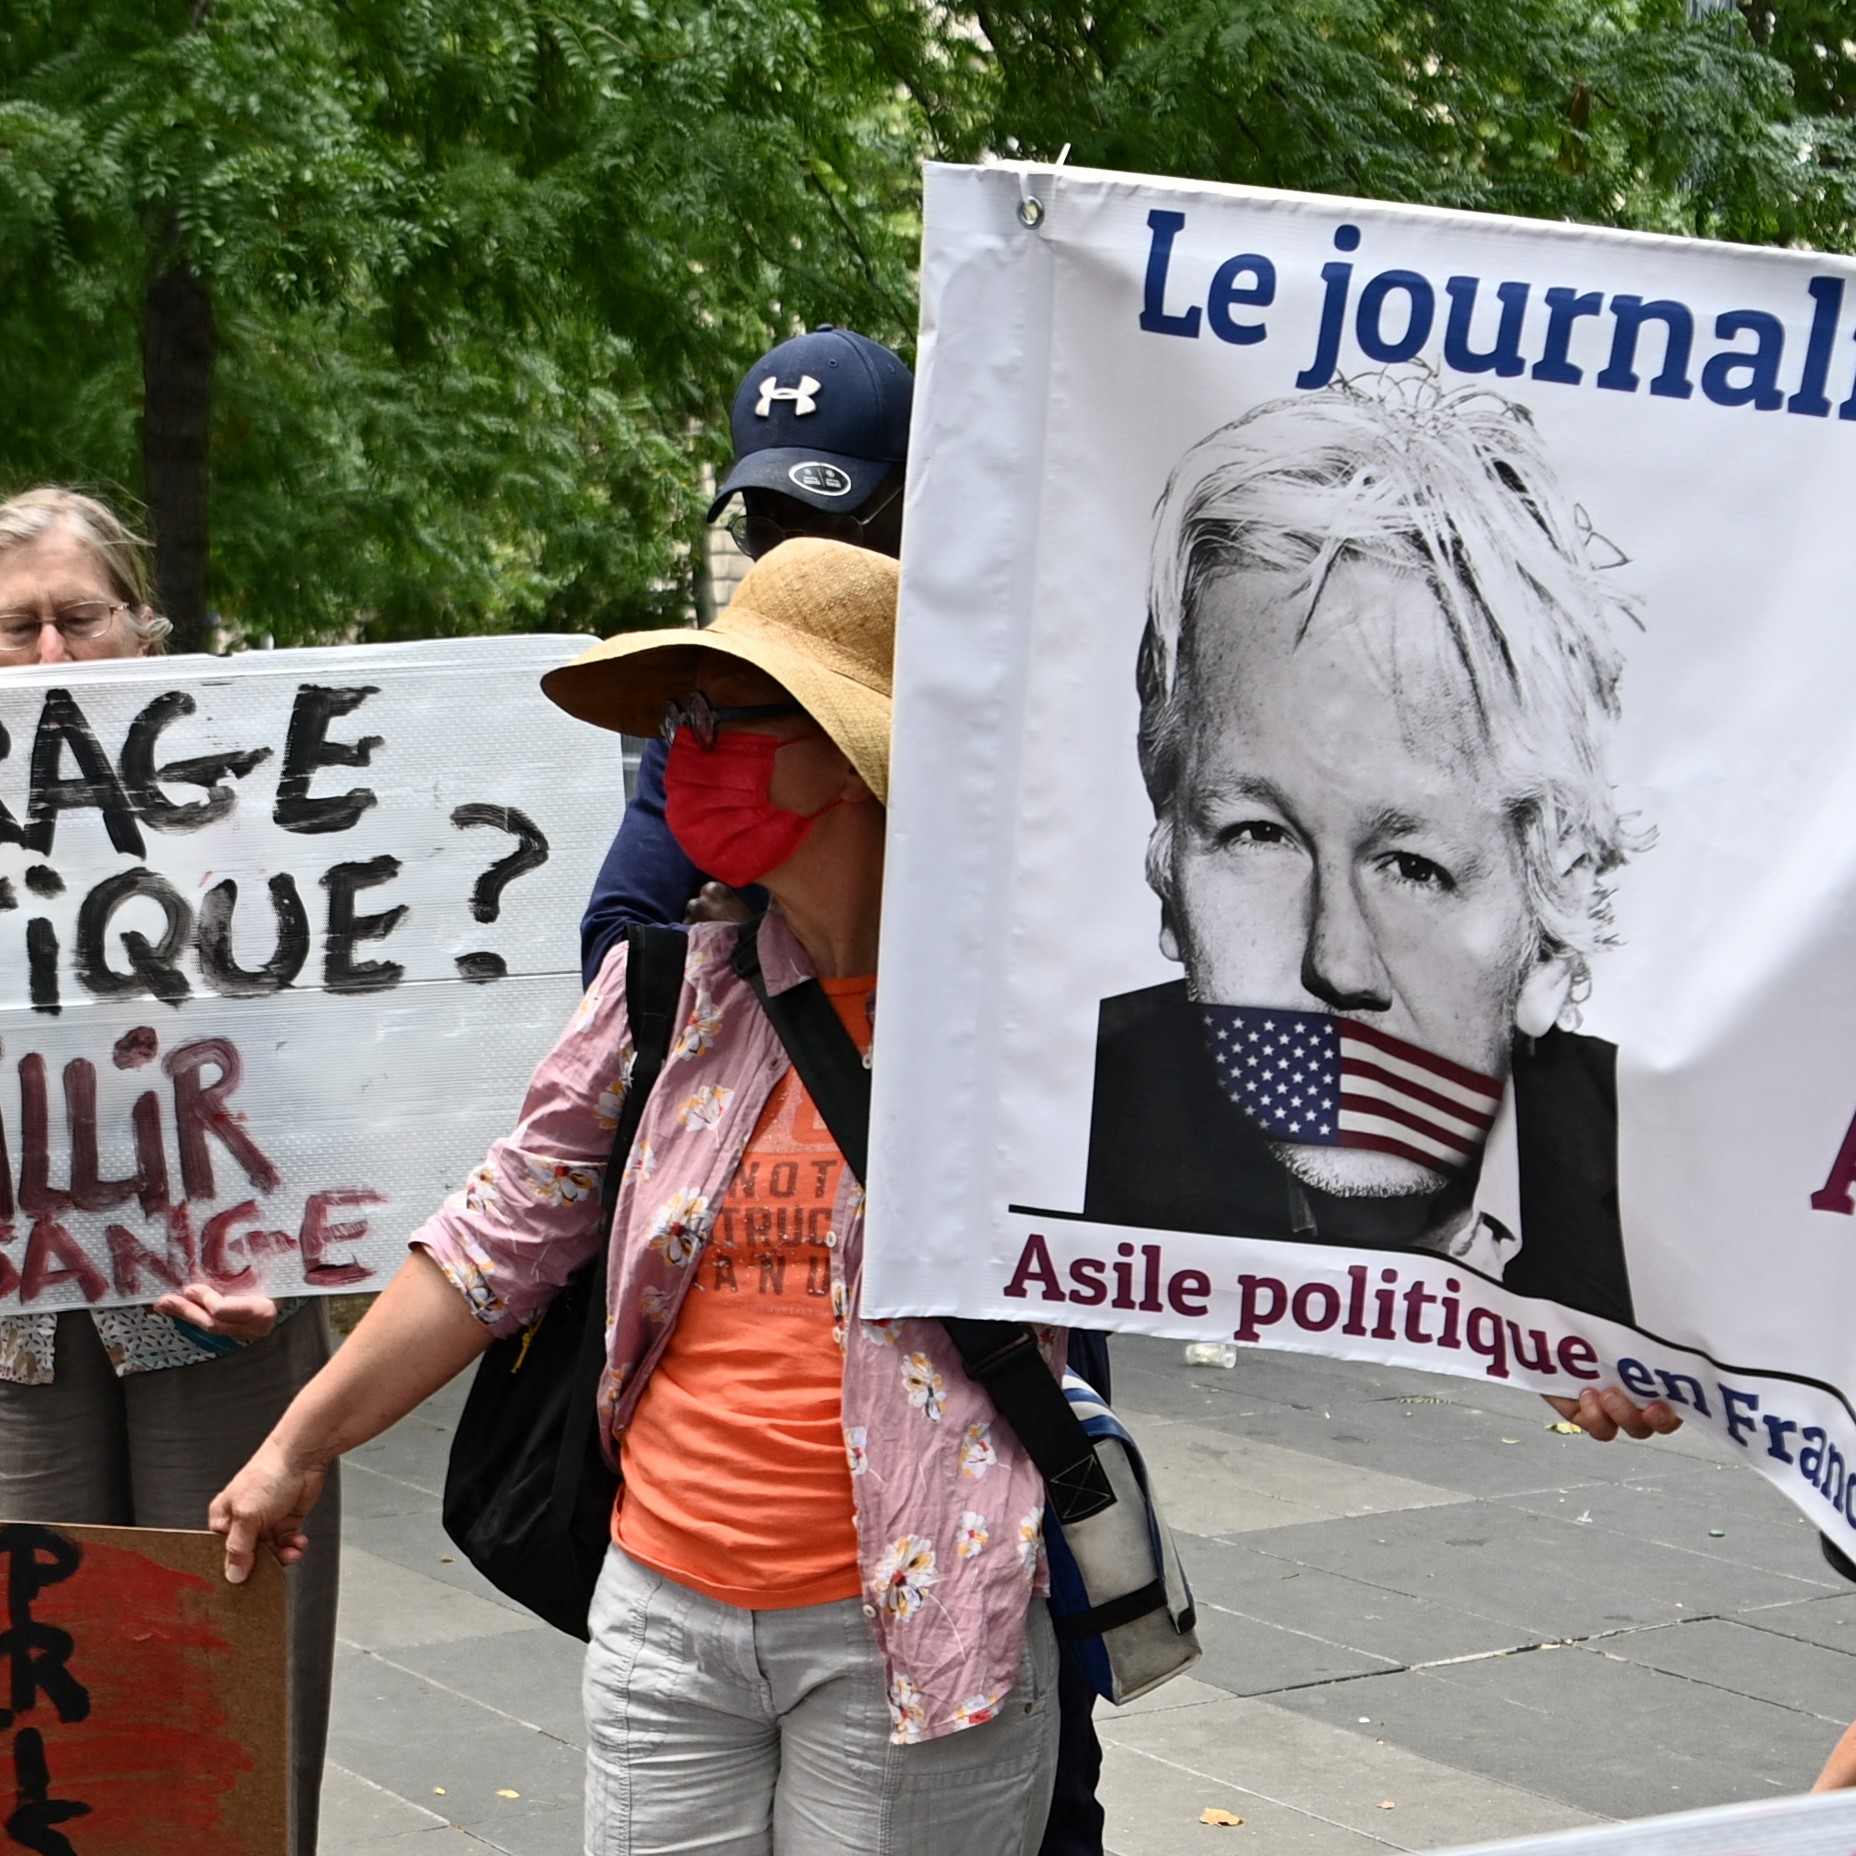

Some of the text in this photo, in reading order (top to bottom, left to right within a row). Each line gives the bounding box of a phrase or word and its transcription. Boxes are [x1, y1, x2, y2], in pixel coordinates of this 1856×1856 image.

[1138, 208, 1277, 346] Le
[1004, 1233, 1212, 1318] Asile
[1234, 1264, 1601, 1380] politique
[1616, 1356, 1712, 1419] en
